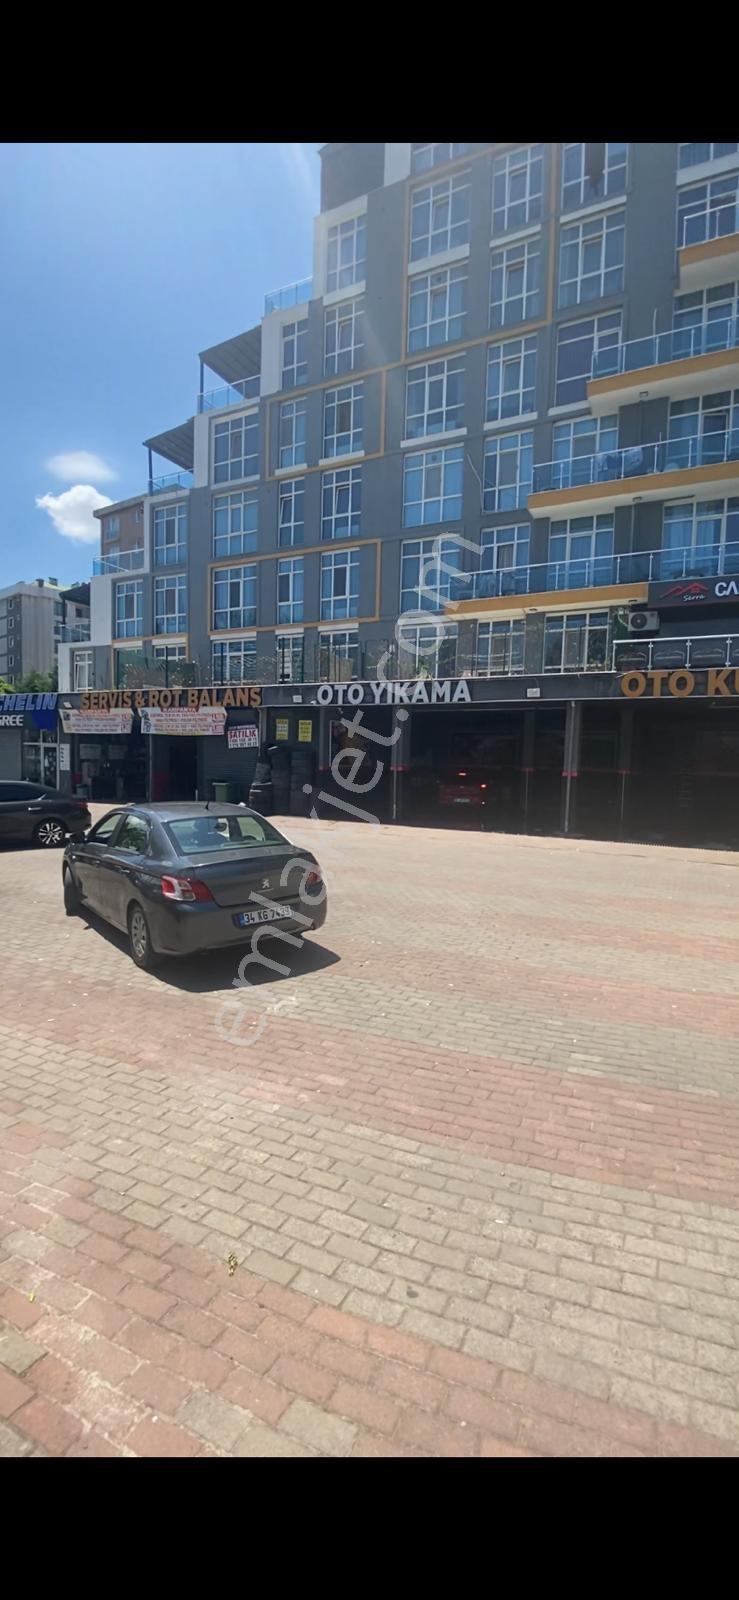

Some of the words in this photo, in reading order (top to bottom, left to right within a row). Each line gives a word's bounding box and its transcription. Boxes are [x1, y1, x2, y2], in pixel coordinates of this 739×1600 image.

[715, 581, 739, 596] CA
[621, 672, 695, 698] OTO
[707, 669, 739, 697] K
[81, 692, 133, 709] SERVIS
[135, 690, 145, 708] &
[148, 689, 182, 707] ROT
[187, 688, 262, 707] BALANS
[316, 684, 365, 706] OTO
[368, 680, 472, 704] YIKAMA
[0, 715, 24, 726] REE
[229, 730, 257, 740] SATILIK
[244, 913, 255, 923] 34
